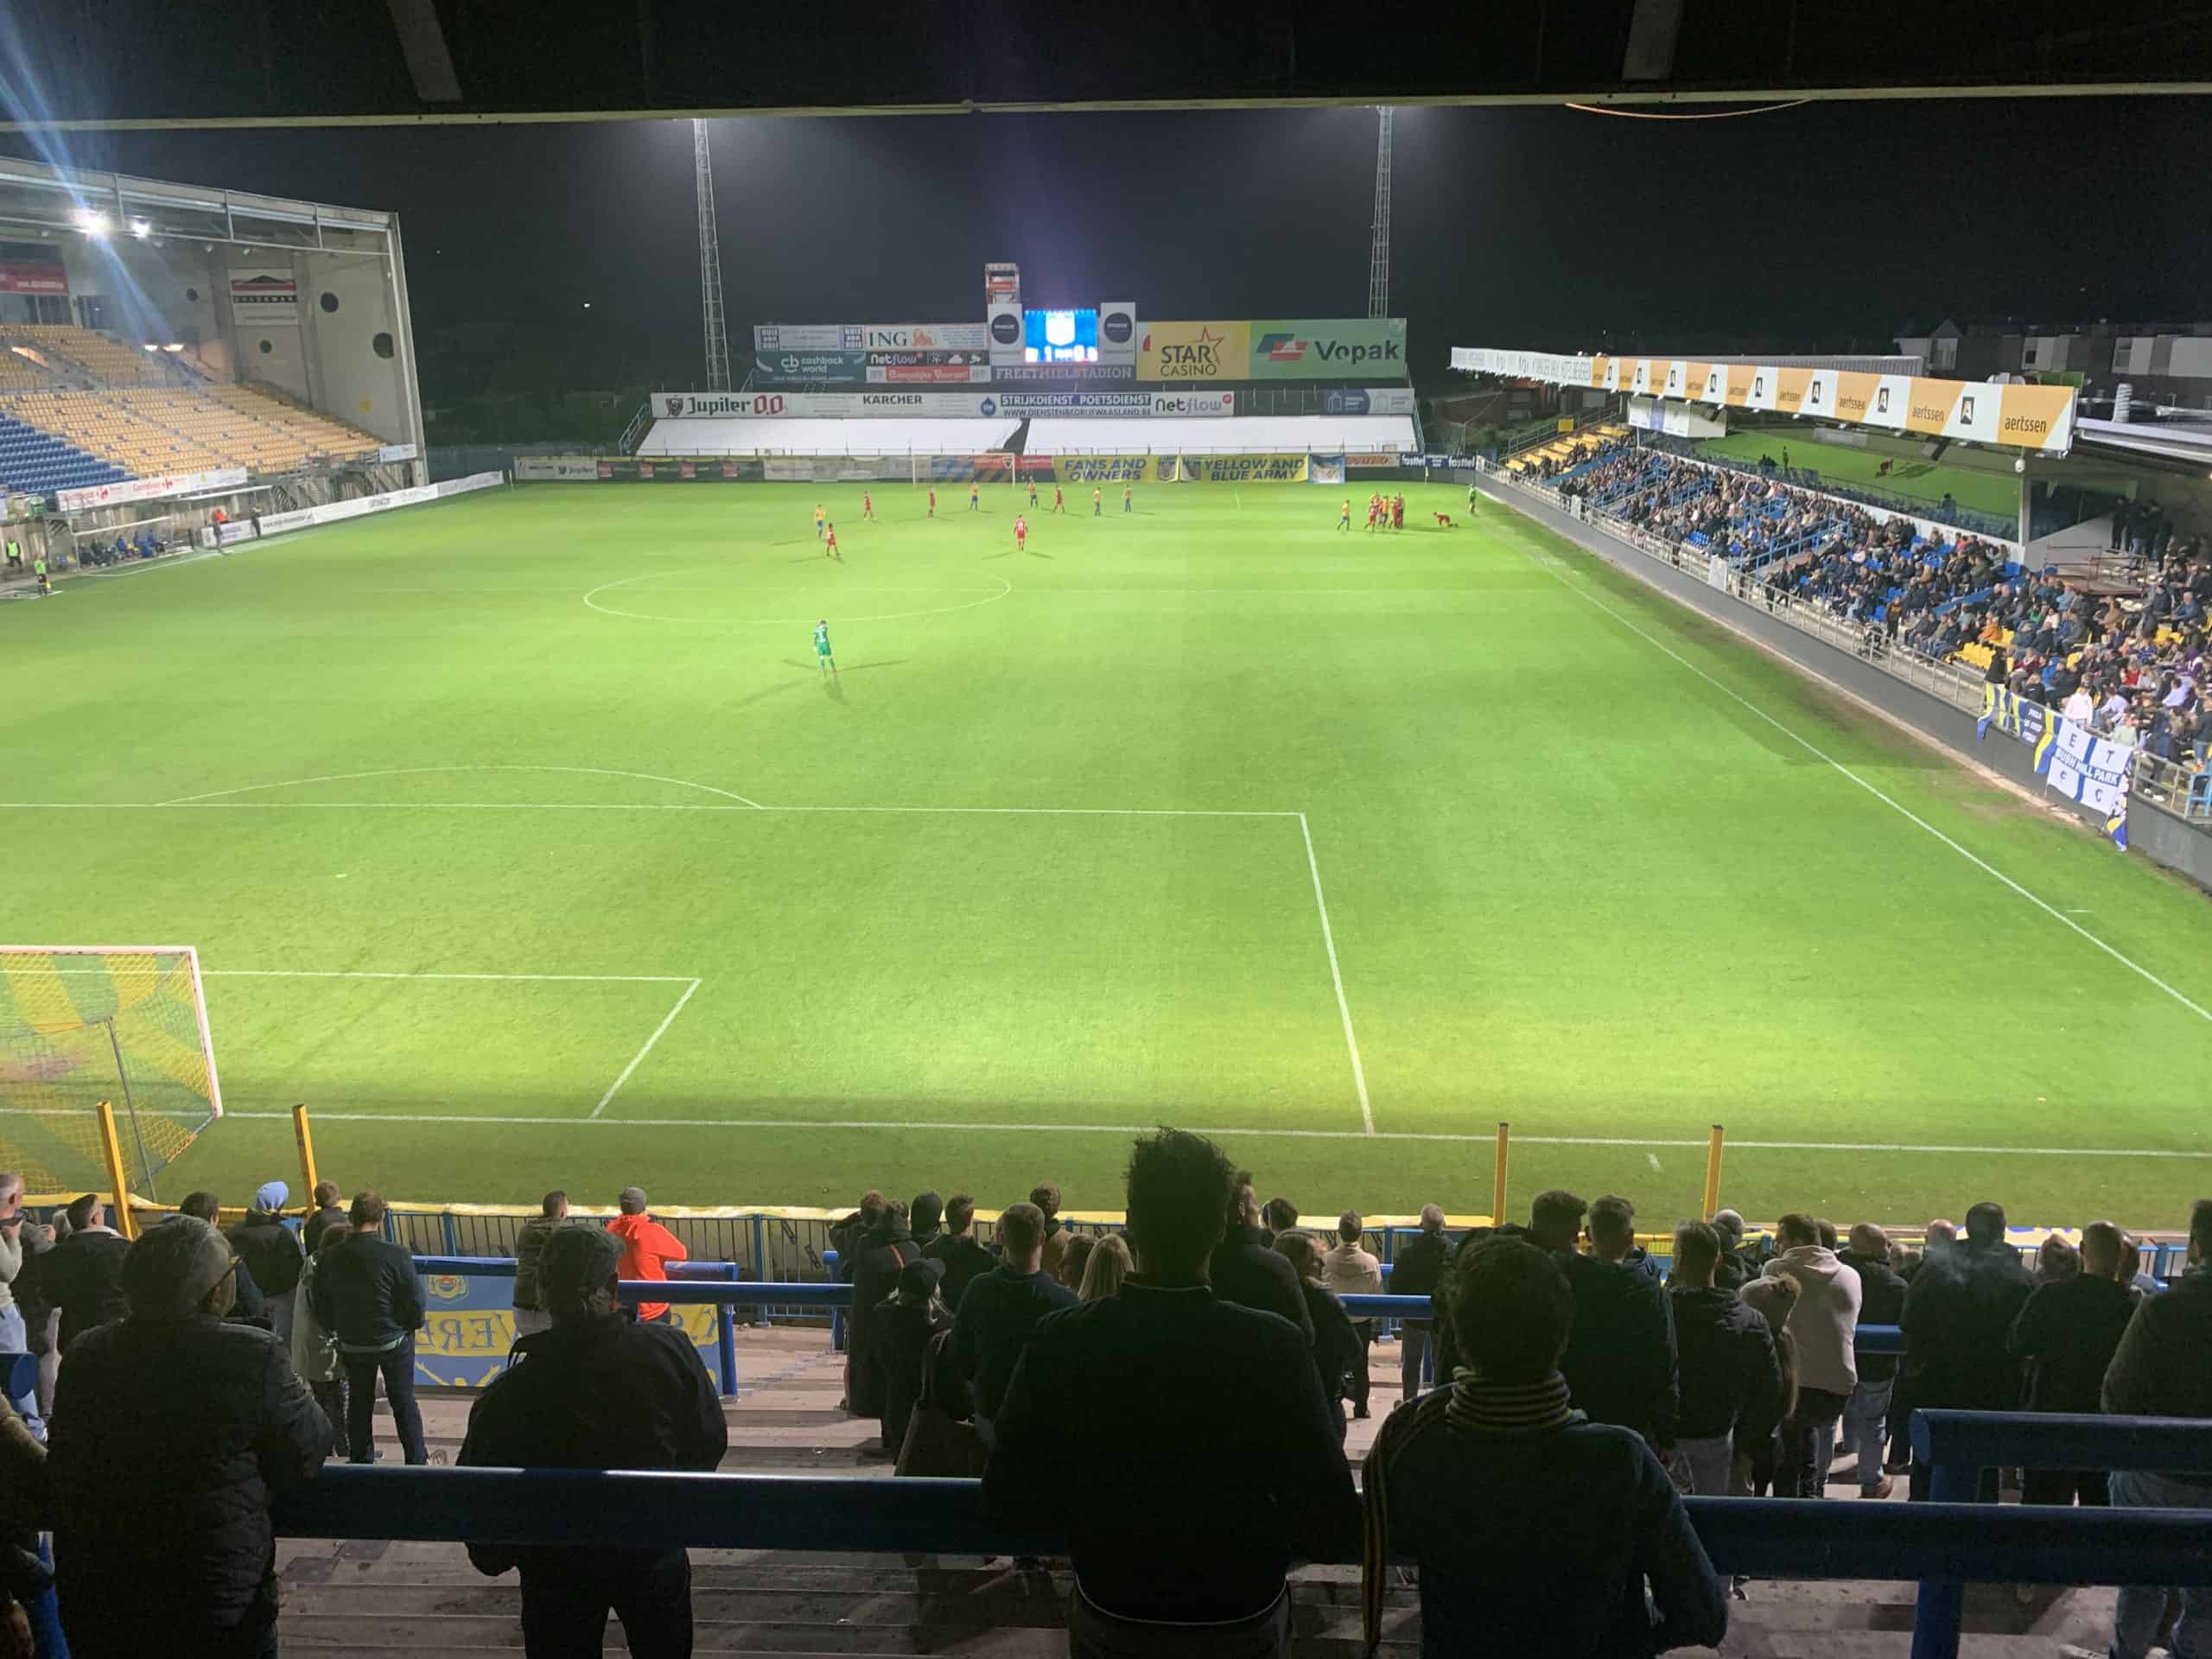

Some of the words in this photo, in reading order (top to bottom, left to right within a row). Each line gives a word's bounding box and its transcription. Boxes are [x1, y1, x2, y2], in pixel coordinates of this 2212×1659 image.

[869, 332, 906, 346] ING
[1161, 346, 1214, 364] STAR
[1314, 339, 1399, 365] Vopak
[801, 356, 843, 365] cashback
[1160, 364, 1217, 377] CASINO
[687, 397, 751, 416] Jupiler
[1912, 405, 1944, 423] aertssen
[2005, 416, 2047, 434] aertssen
[1065, 459, 1109, 471] FANS
[1110, 458, 1147, 470] AND
[1205, 459, 1268, 470] YELLOW
[1271, 459, 1305, 469] AND
[1070, 470, 1141, 481] OWNERS
[1211, 470, 1249, 480] BLUE
[1252, 470, 1299, 480] ARMY
